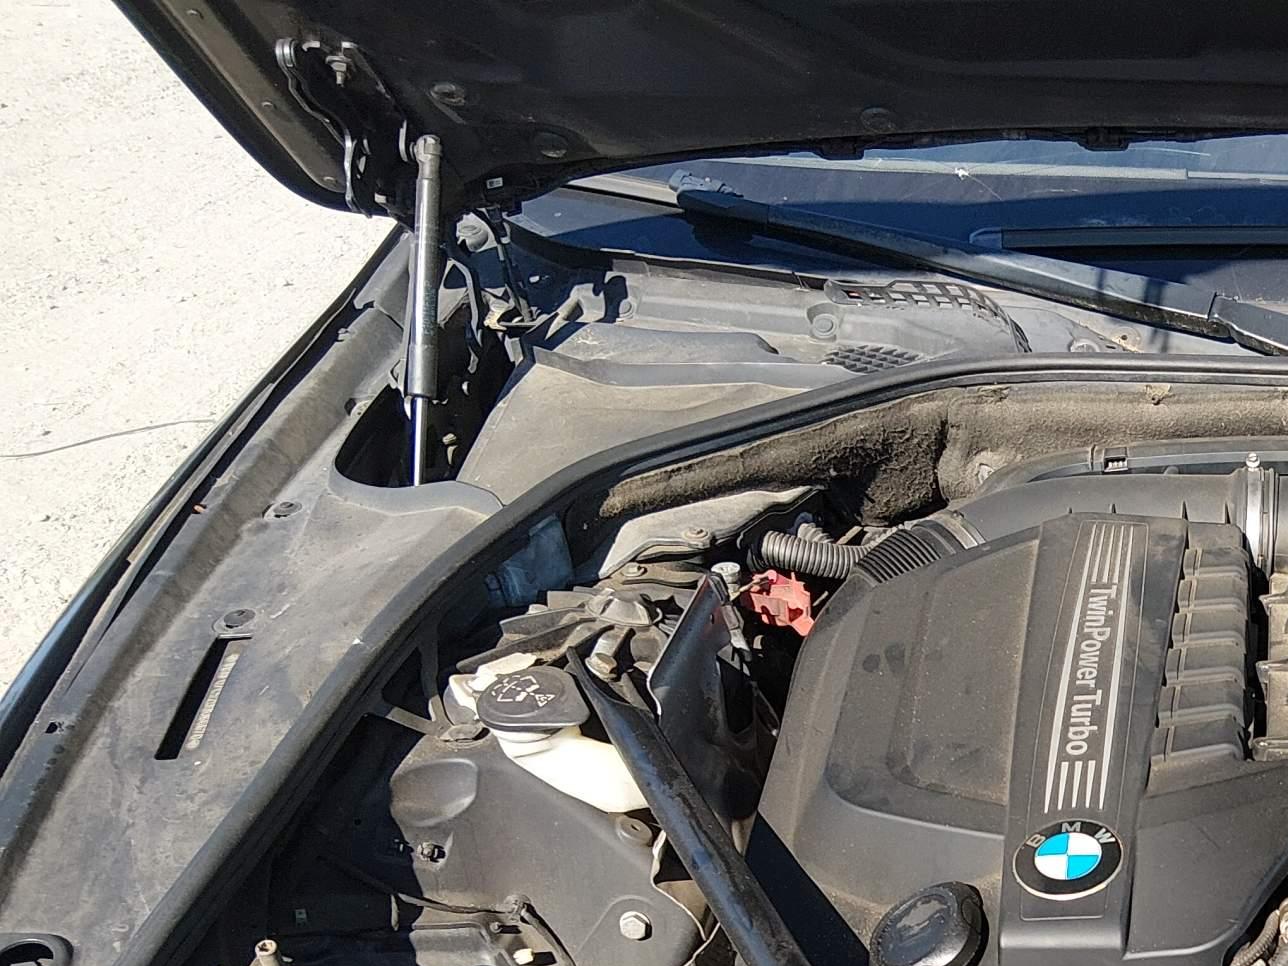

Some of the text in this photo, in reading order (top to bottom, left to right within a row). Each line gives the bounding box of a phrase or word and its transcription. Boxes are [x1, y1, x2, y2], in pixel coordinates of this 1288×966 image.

[1065, 586, 1117, 756] TwinPower Turbo
[1026, 821, 1116, 849] BMW
